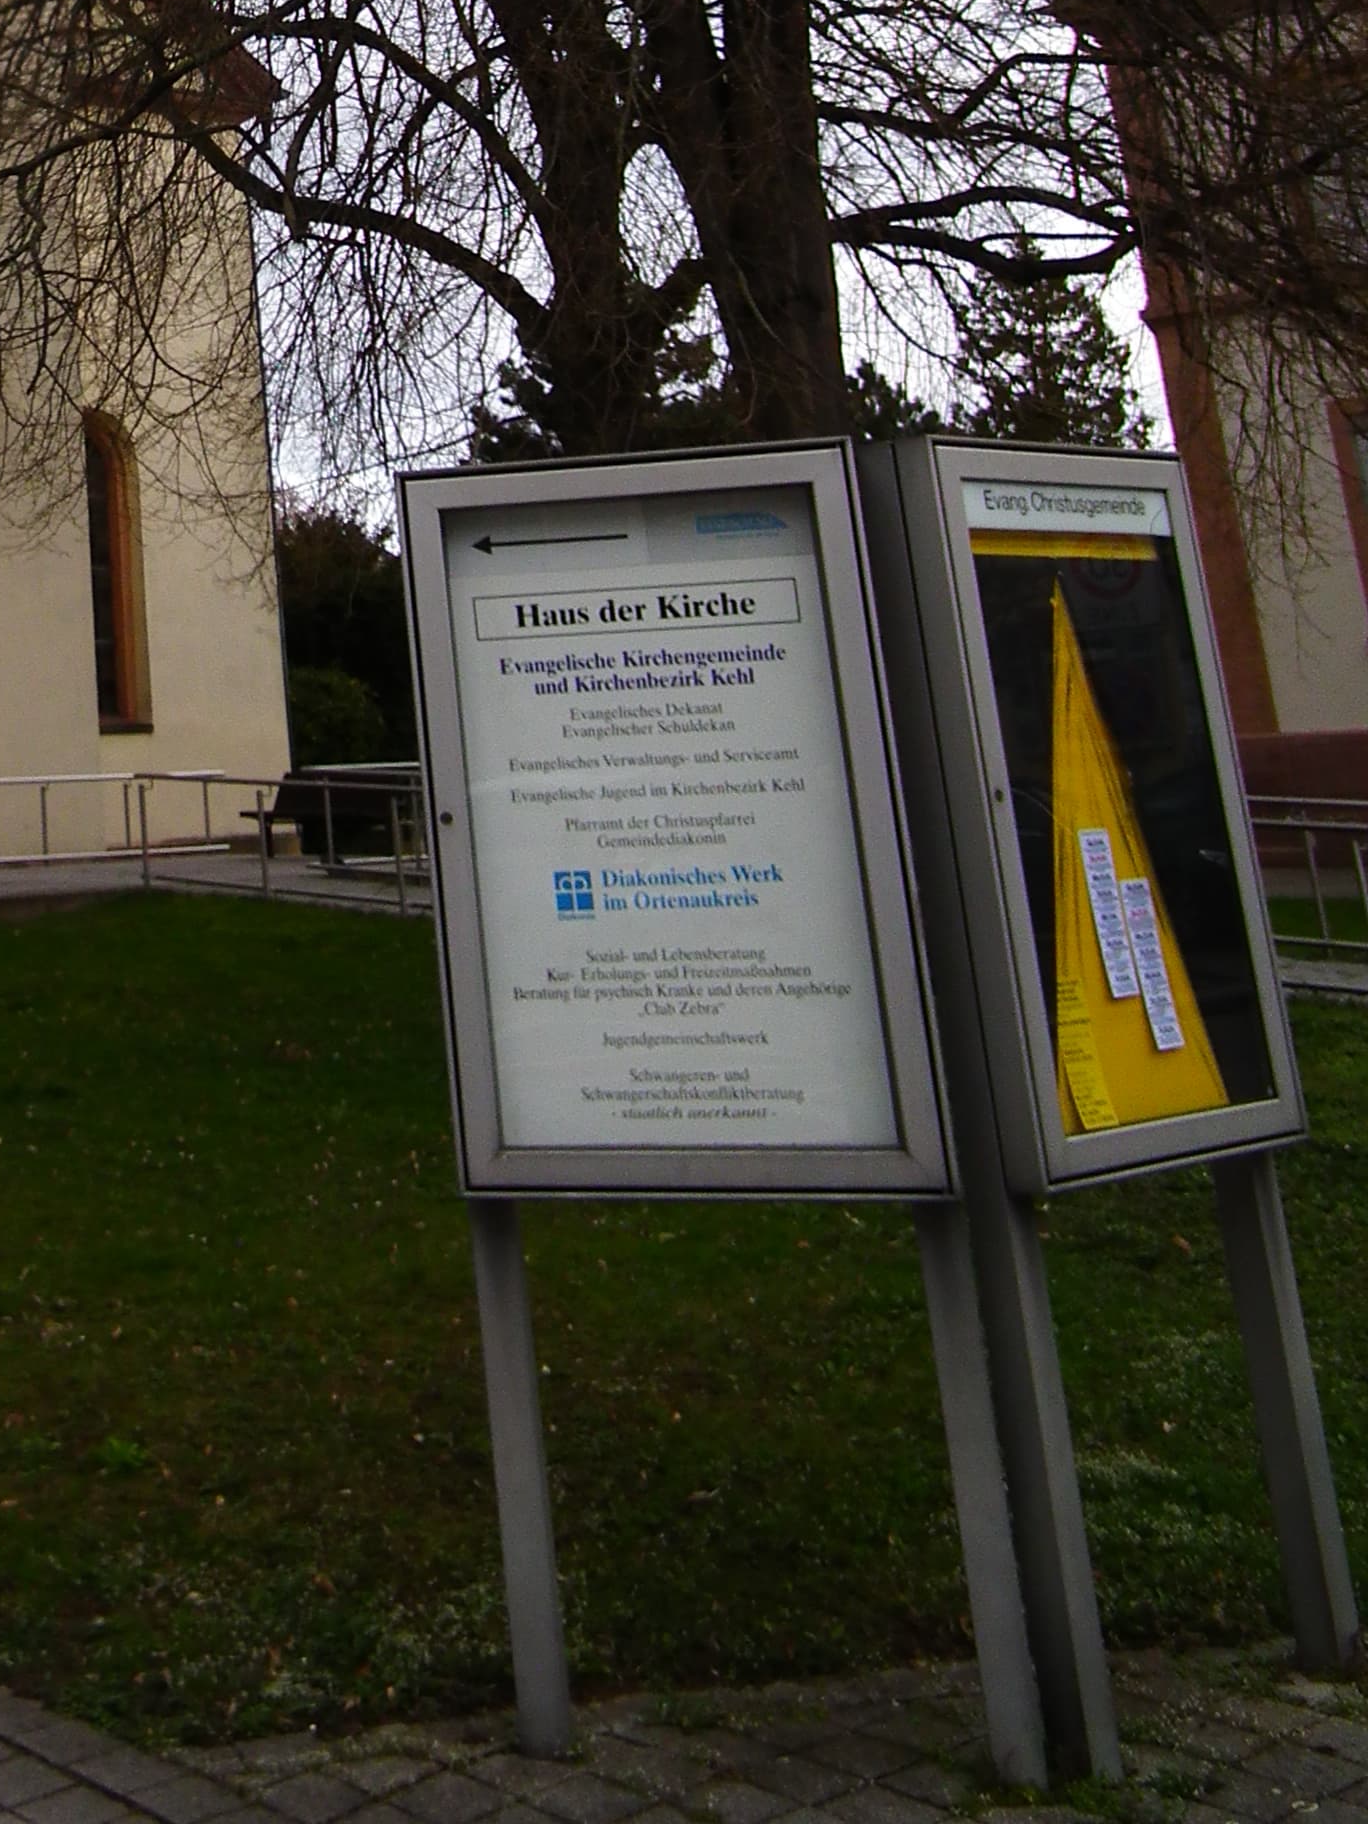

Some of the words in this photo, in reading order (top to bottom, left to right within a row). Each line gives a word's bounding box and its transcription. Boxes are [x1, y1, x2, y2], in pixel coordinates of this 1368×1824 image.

[515, 603, 589, 628] Haus
[599, 599, 646, 623] der
[657, 593, 756, 620] Kirche
[500, 651, 616, 676] Evangelische
[623, 644, 787, 668] Kirchengemeinde
[534, 677, 568, 695] und
[575, 671, 704, 693] Kirchenbezirk
[711, 668, 755, 685] Kehl
[569, 708, 662, 723] Evangelisches
[665, 703, 723, 717] Dekanat
[562, 724, 654, 740] Evangelischer
[508, 756, 600, 773] Evangelisches
[694, 749, 720, 763] und
[650, 784, 668, 796] im
[771, 778, 804, 792] Kehl
[628, 816, 649, 829] der
[601, 866, 727, 887] Diakonisches
[731, 863, 783, 882] Werk
[603, 894, 627, 910] im
[634, 889, 759, 909] Ortenaukreis
[633, 949, 657, 961] und
